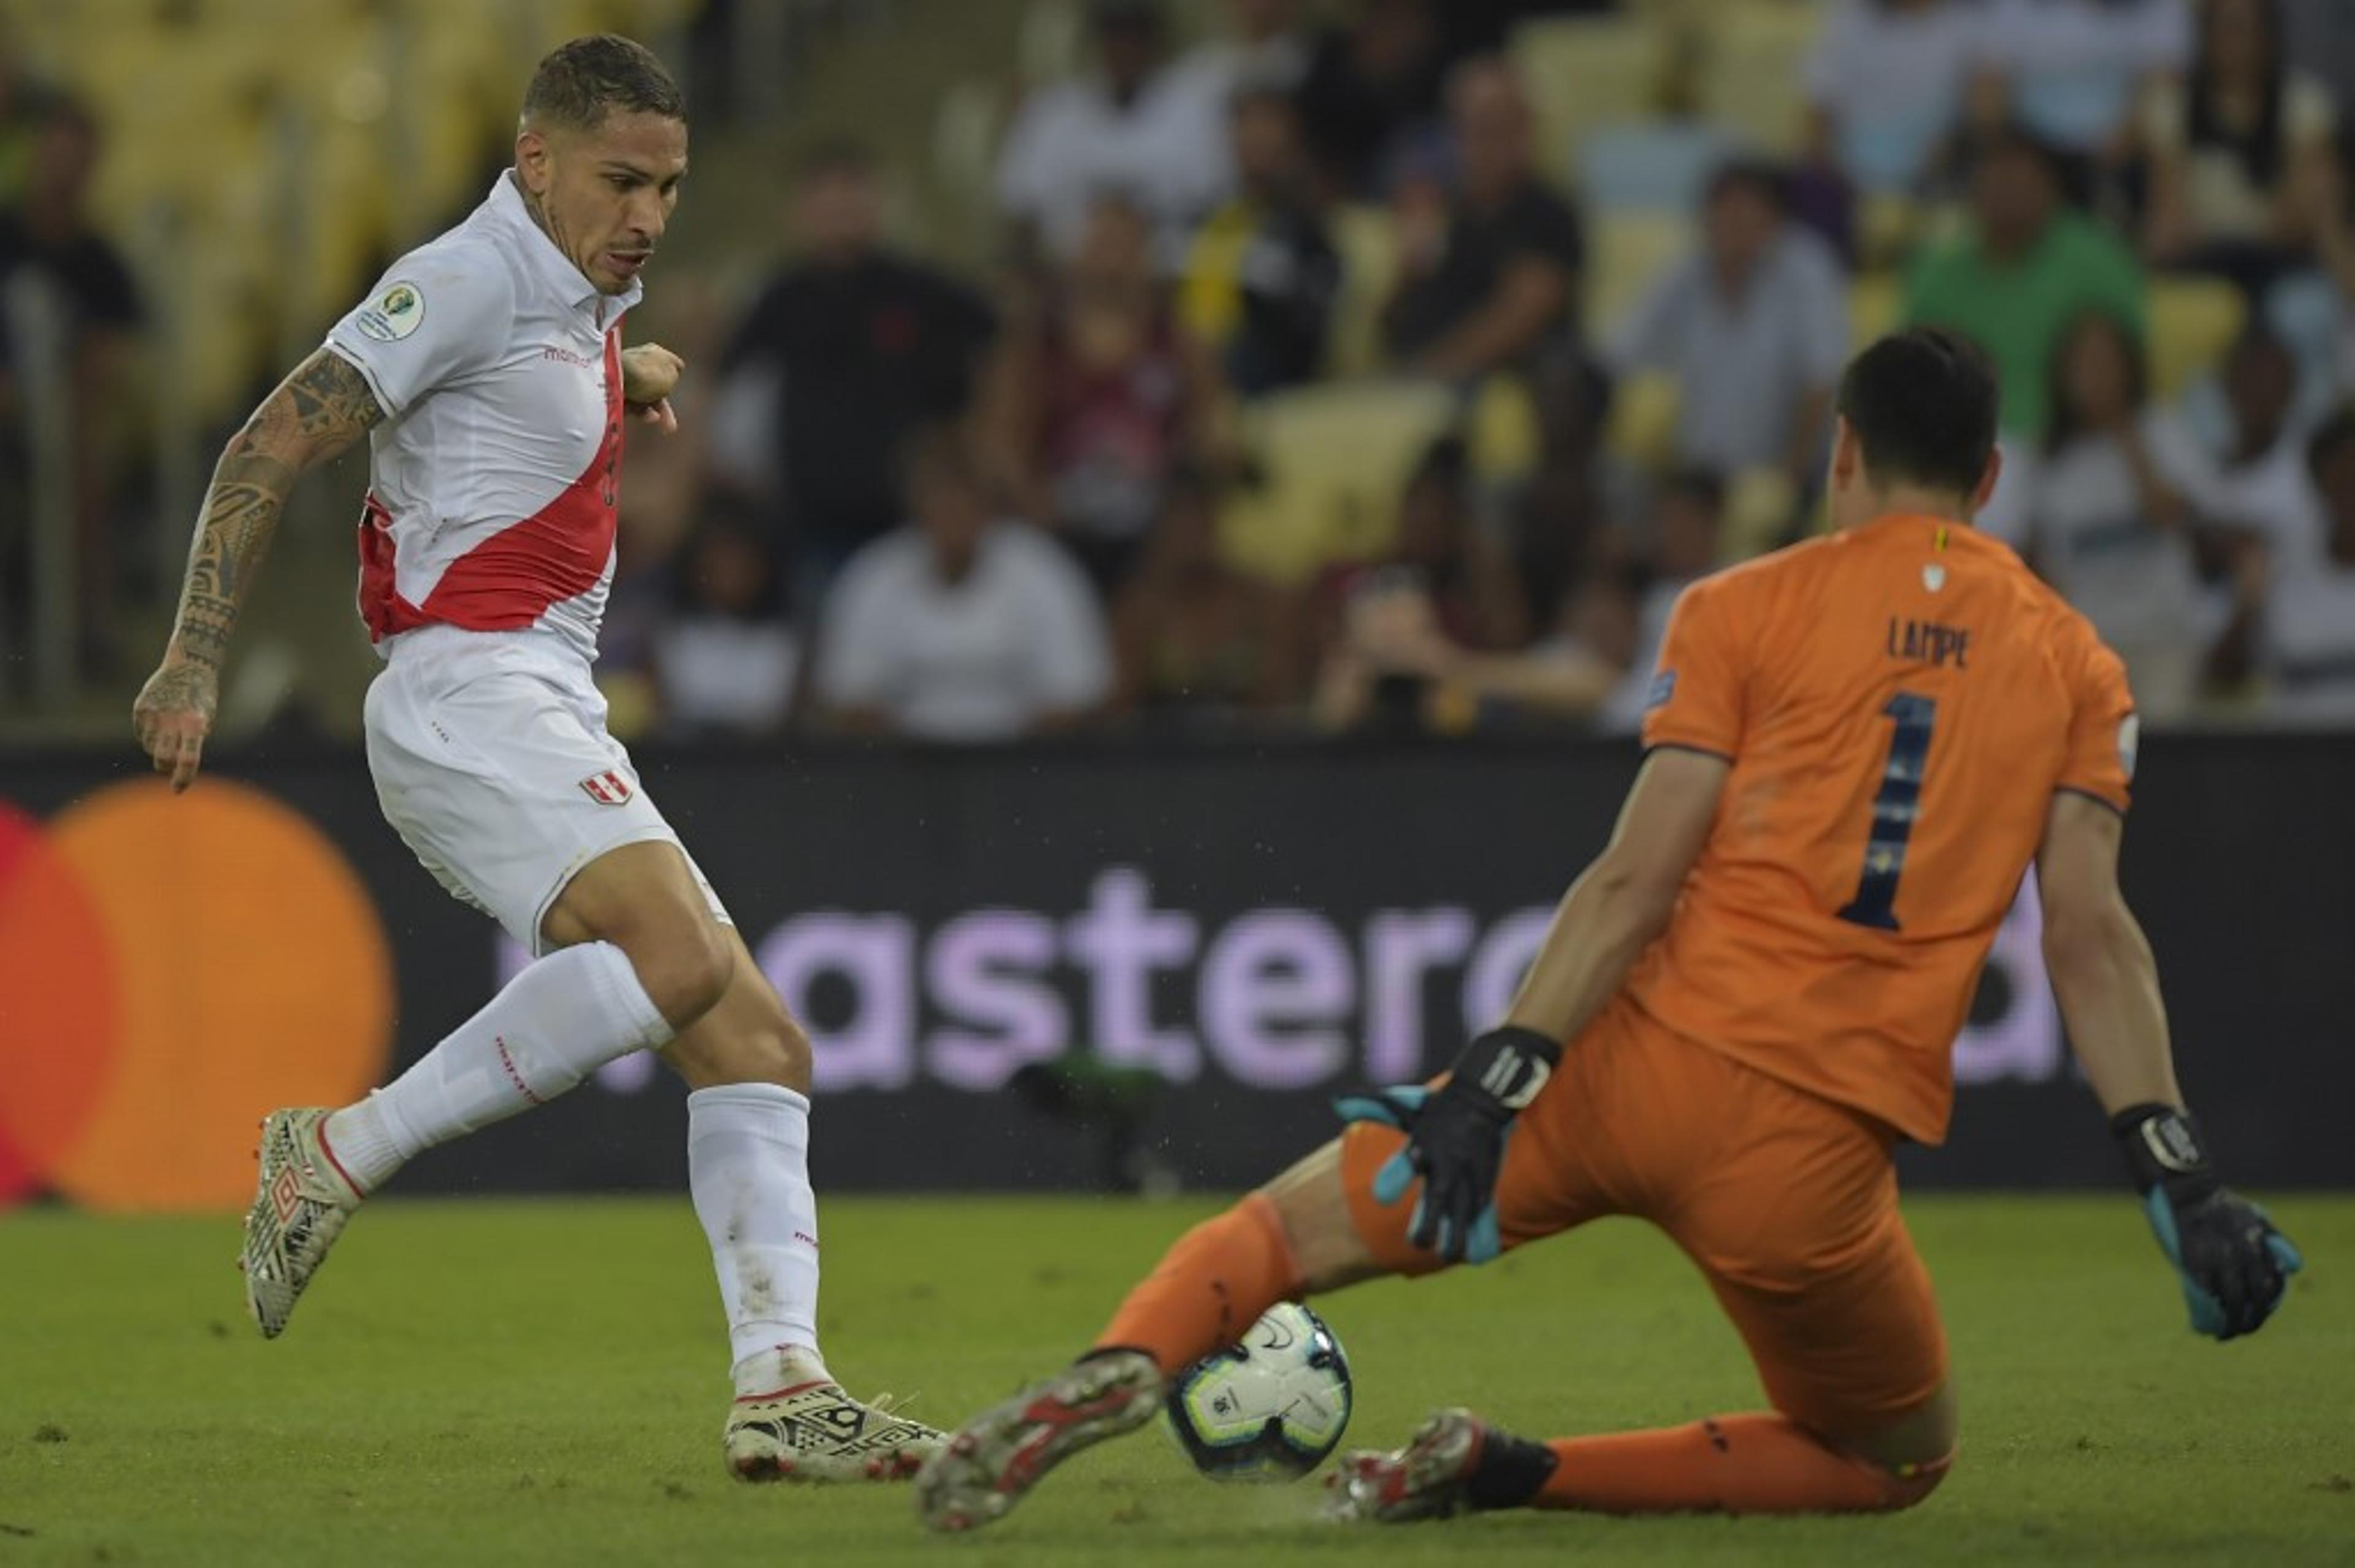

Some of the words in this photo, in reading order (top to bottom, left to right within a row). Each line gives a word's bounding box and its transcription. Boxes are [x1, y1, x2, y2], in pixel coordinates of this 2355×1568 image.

[1886, 616, 1972, 668] LAMPE
[1835, 690, 1937, 932] 1
[498, 857, 2062, 1088] asterd
